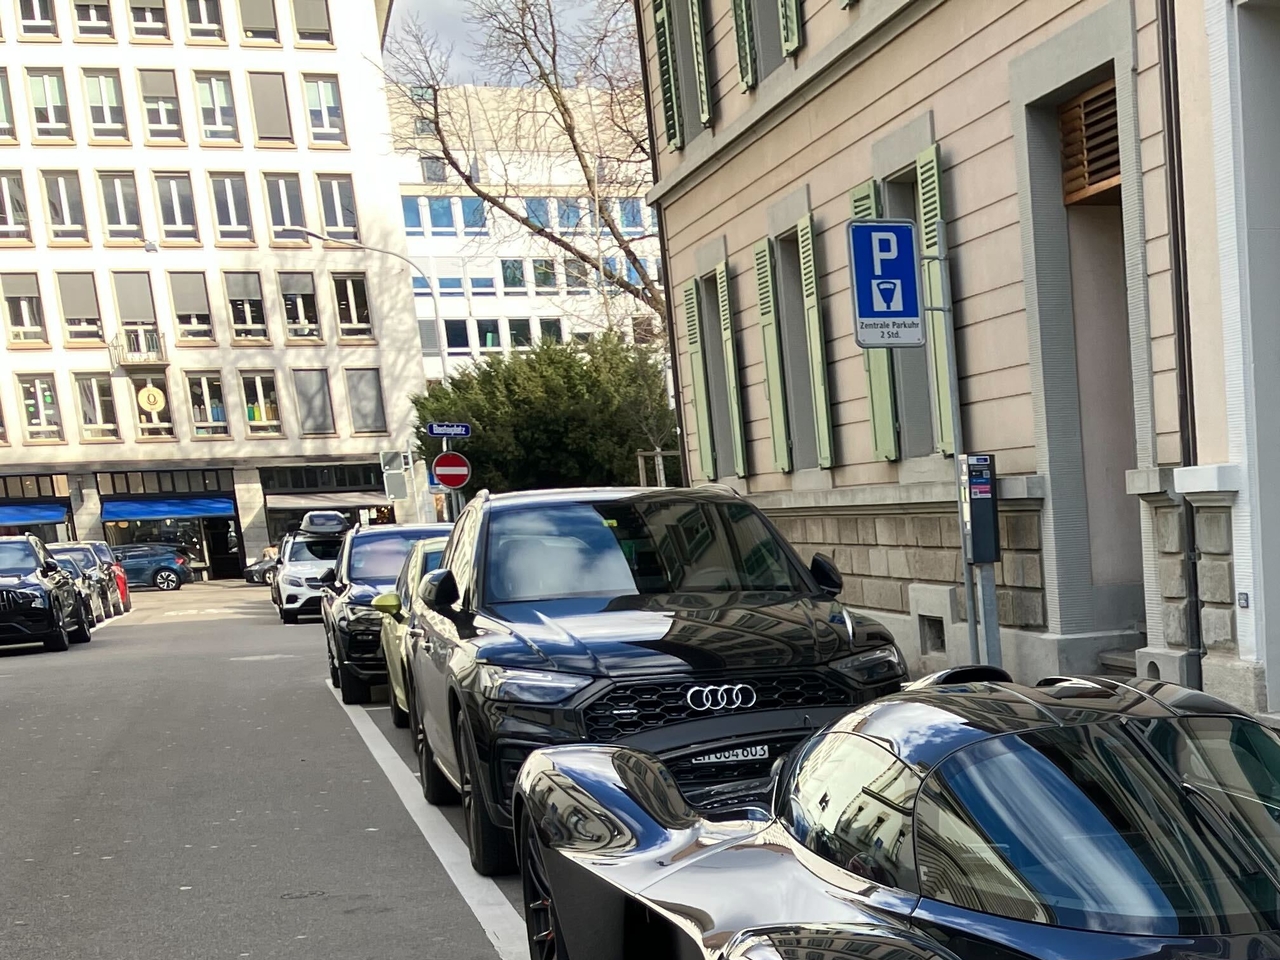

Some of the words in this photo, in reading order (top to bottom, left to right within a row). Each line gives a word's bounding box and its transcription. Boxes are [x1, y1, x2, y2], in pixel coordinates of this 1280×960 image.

[871, 232, 898, 276] P
[860, 321, 890, 330] Zentrale
[892, 321, 920, 330] Parkuhr
[887, 330, 901, 339] Std.
